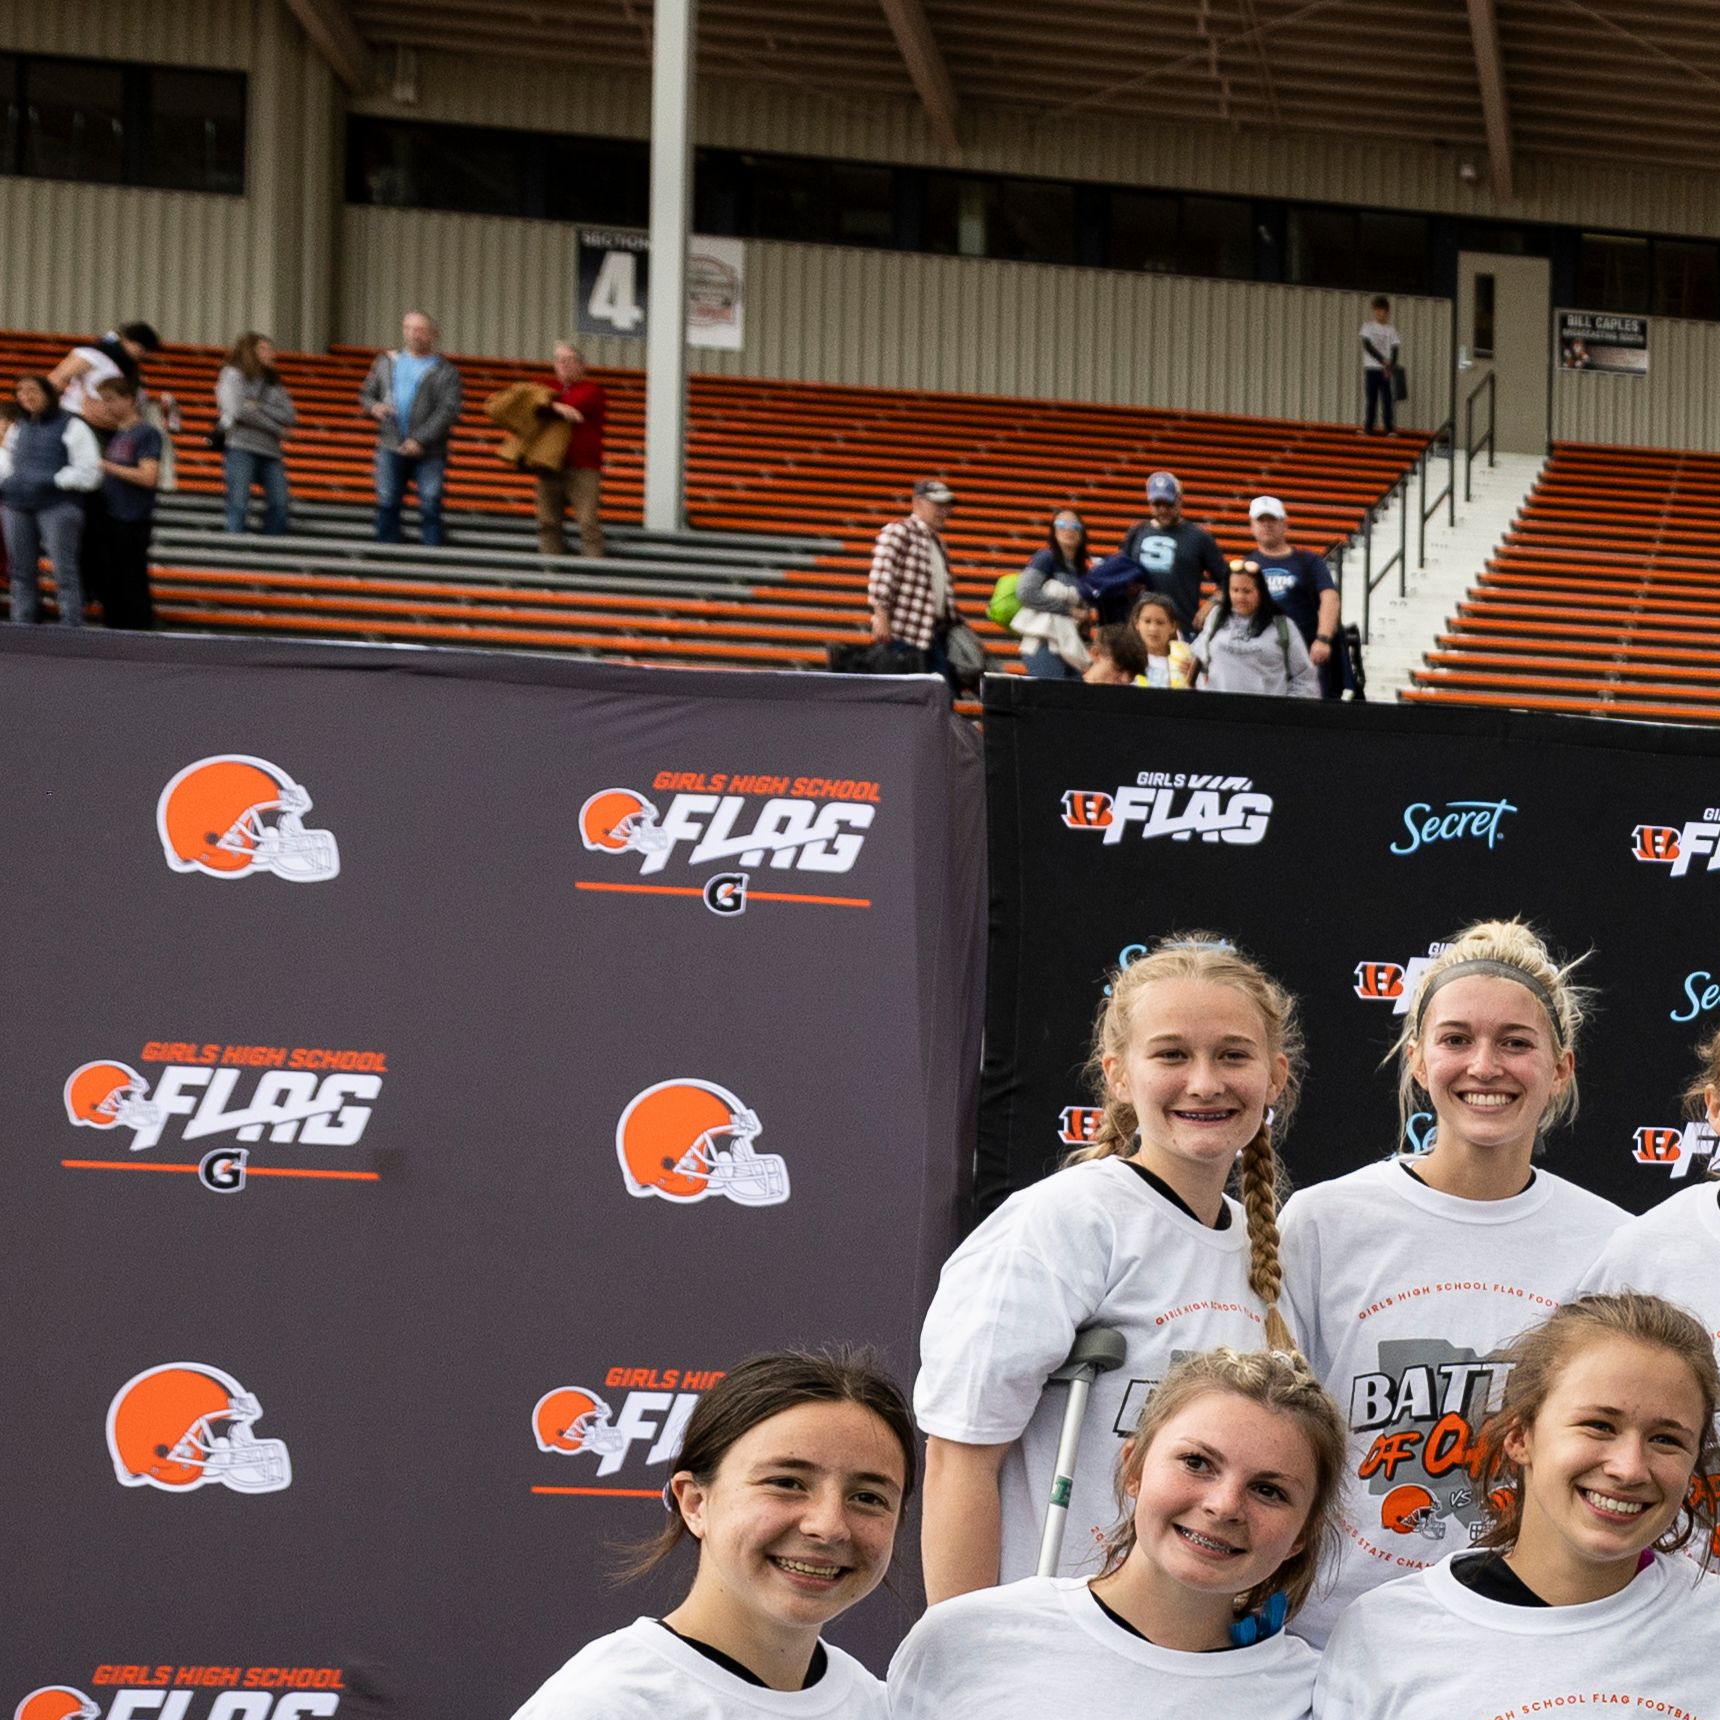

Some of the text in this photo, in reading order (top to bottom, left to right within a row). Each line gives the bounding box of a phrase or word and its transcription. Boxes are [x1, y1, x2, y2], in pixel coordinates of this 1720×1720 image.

[588, 251, 644, 330] 4
[1567, 315, 1591, 327] BILL
[1140, 536, 1177, 573] S
[653, 771, 881, 801] GIRLS HIGH SCHOOL
[1136, 771, 1186, 787] GIRLS
[1103, 786, 1273, 845] FLAG
[1391, 798, 1518, 855] Secret
[640, 793, 875, 876] FLAG
[141, 1041, 388, 1072] GIRLS HIGH SCHOOL
[130, 1066, 382, 1151] FLAG
[605, 1367, 680, 1389] GIRLS
[1358, 1430, 1423, 1481] OF
[92, 1664, 345, 1689] GIRLS HIGH SCHOOL
[1522, 1694, 1586, 1715] SCHOOL
[1593, 1693, 1630, 1705] FLAG
